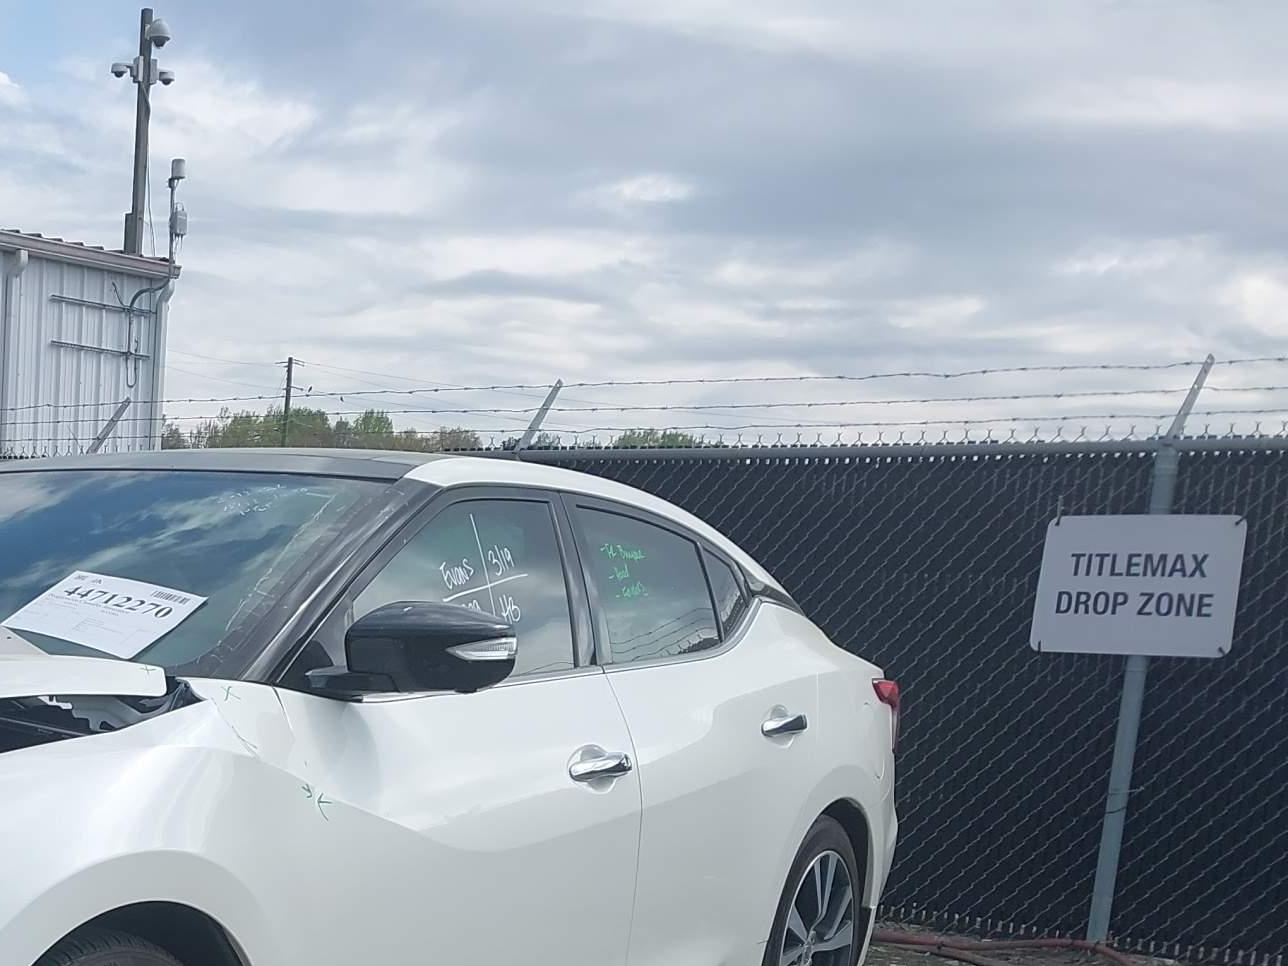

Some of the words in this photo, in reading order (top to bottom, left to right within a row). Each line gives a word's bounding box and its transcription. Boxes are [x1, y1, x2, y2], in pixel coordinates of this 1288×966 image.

[487, 545, 515, 576] 3/19
[1070, 553, 1210, 578] TITLEMAX
[63, 585, 173, 618] 44712270
[1055, 591, 1129, 615] DROP
[1136, 592, 1215, 618] ZONE
